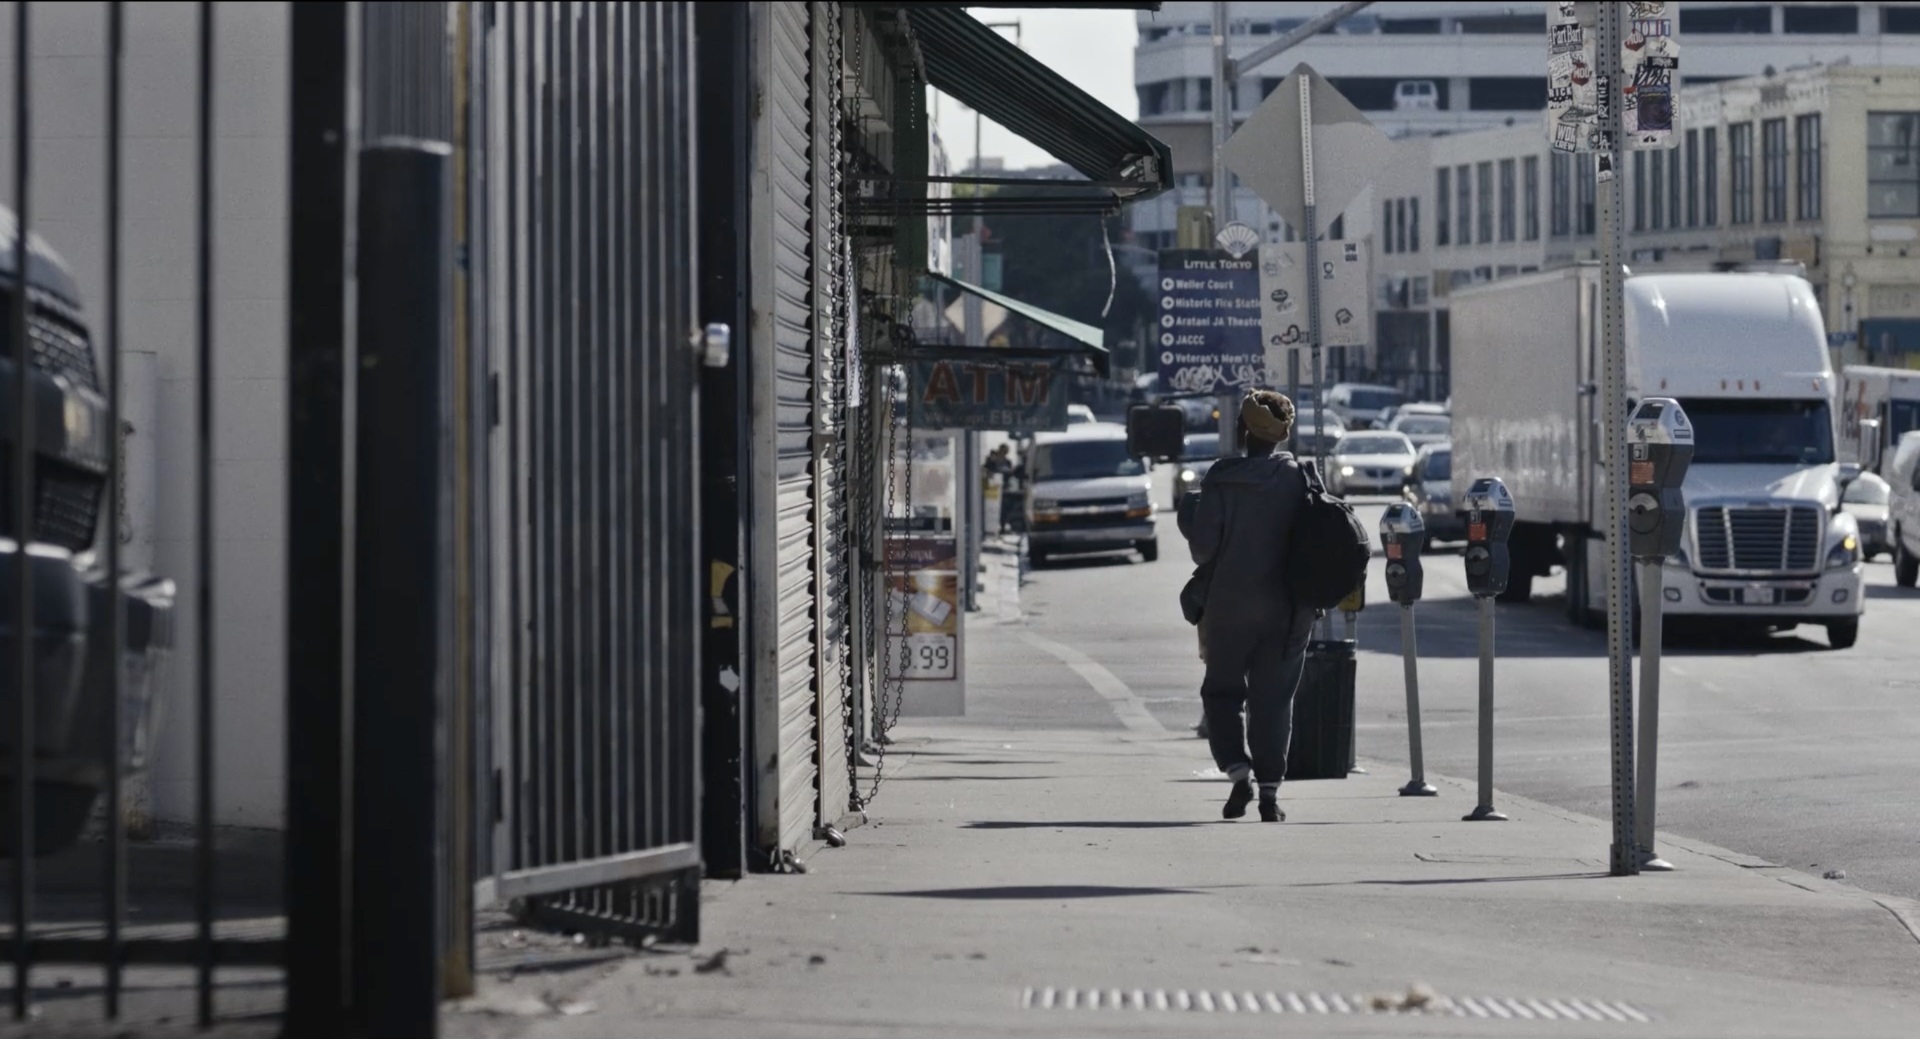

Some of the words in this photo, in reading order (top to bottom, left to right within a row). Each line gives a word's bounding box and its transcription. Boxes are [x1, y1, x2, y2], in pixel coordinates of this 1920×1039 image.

[1176, 279, 1206, 290] Weller
[1207, 279, 1234, 290] Court
[1176, 298, 1213, 309] Historic
[1215, 298, 1234, 309] Fire
[1176, 316, 1211, 327] Aratani
[1212, 316, 1225, 327] JA
[1176, 335, 1205, 346] JACCC
[1176, 353, 1219, 363] Veteran's
[922, 359, 1051, 406] ATM
[989, 409, 1026, 426] EBT
